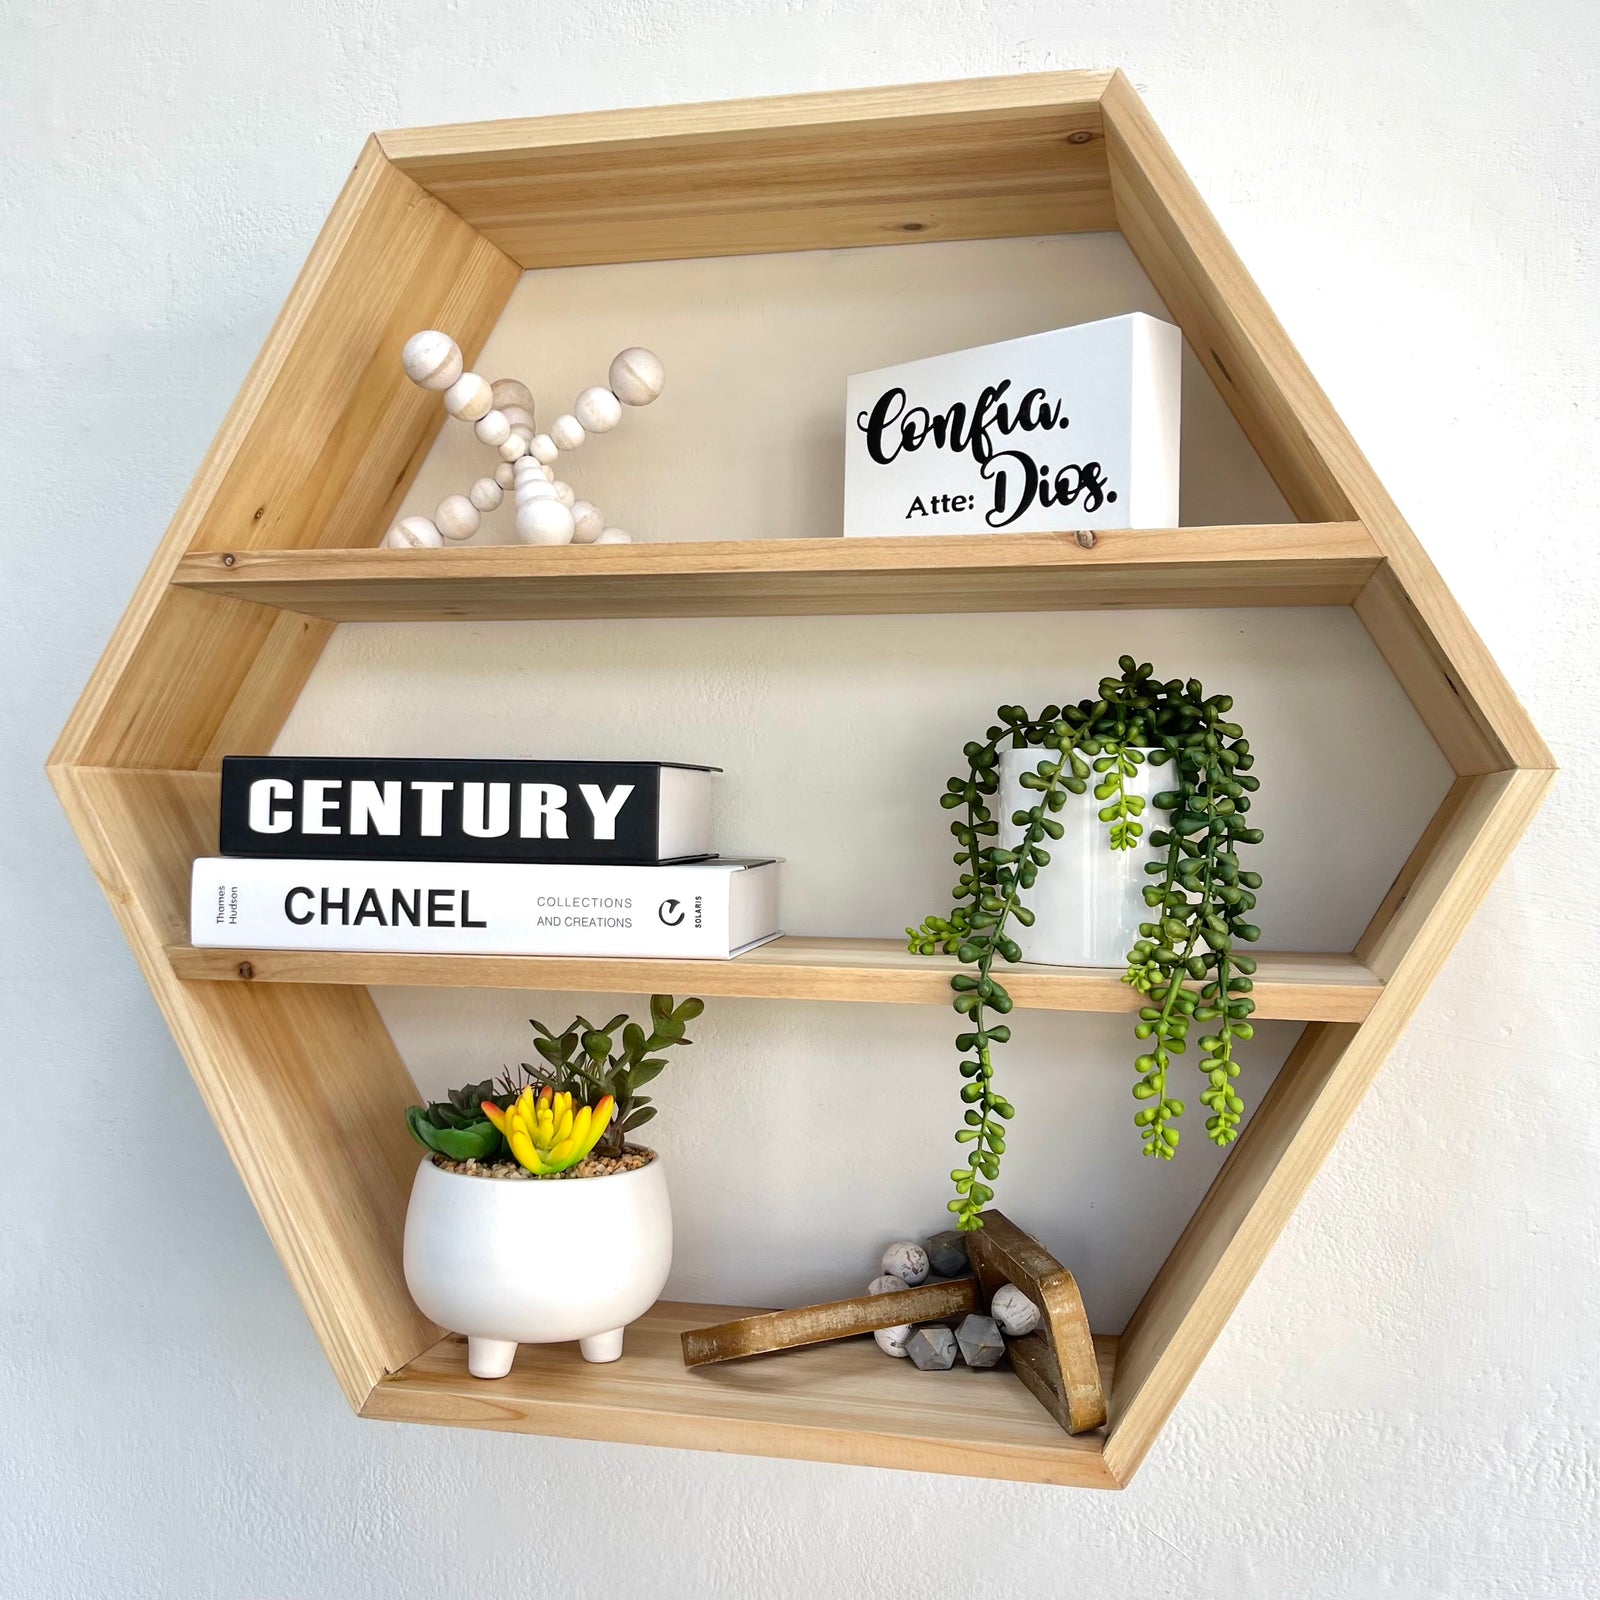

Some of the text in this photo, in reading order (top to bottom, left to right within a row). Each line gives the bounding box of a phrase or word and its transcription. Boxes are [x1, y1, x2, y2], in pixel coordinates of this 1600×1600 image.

[905, 449, 1118, 528] Atte: Dios.
[248, 778, 635, 841] CENTURY
[216, 885, 226, 925] Thames
[229, 886, 238, 925] Hudson
[284, 886, 487, 929] CHANEL
[536, 896, 633, 909] COLLECTIONS
[536, 916, 633, 928] AND CREATIONS
[694, 895, 703, 929] SOLARIS
